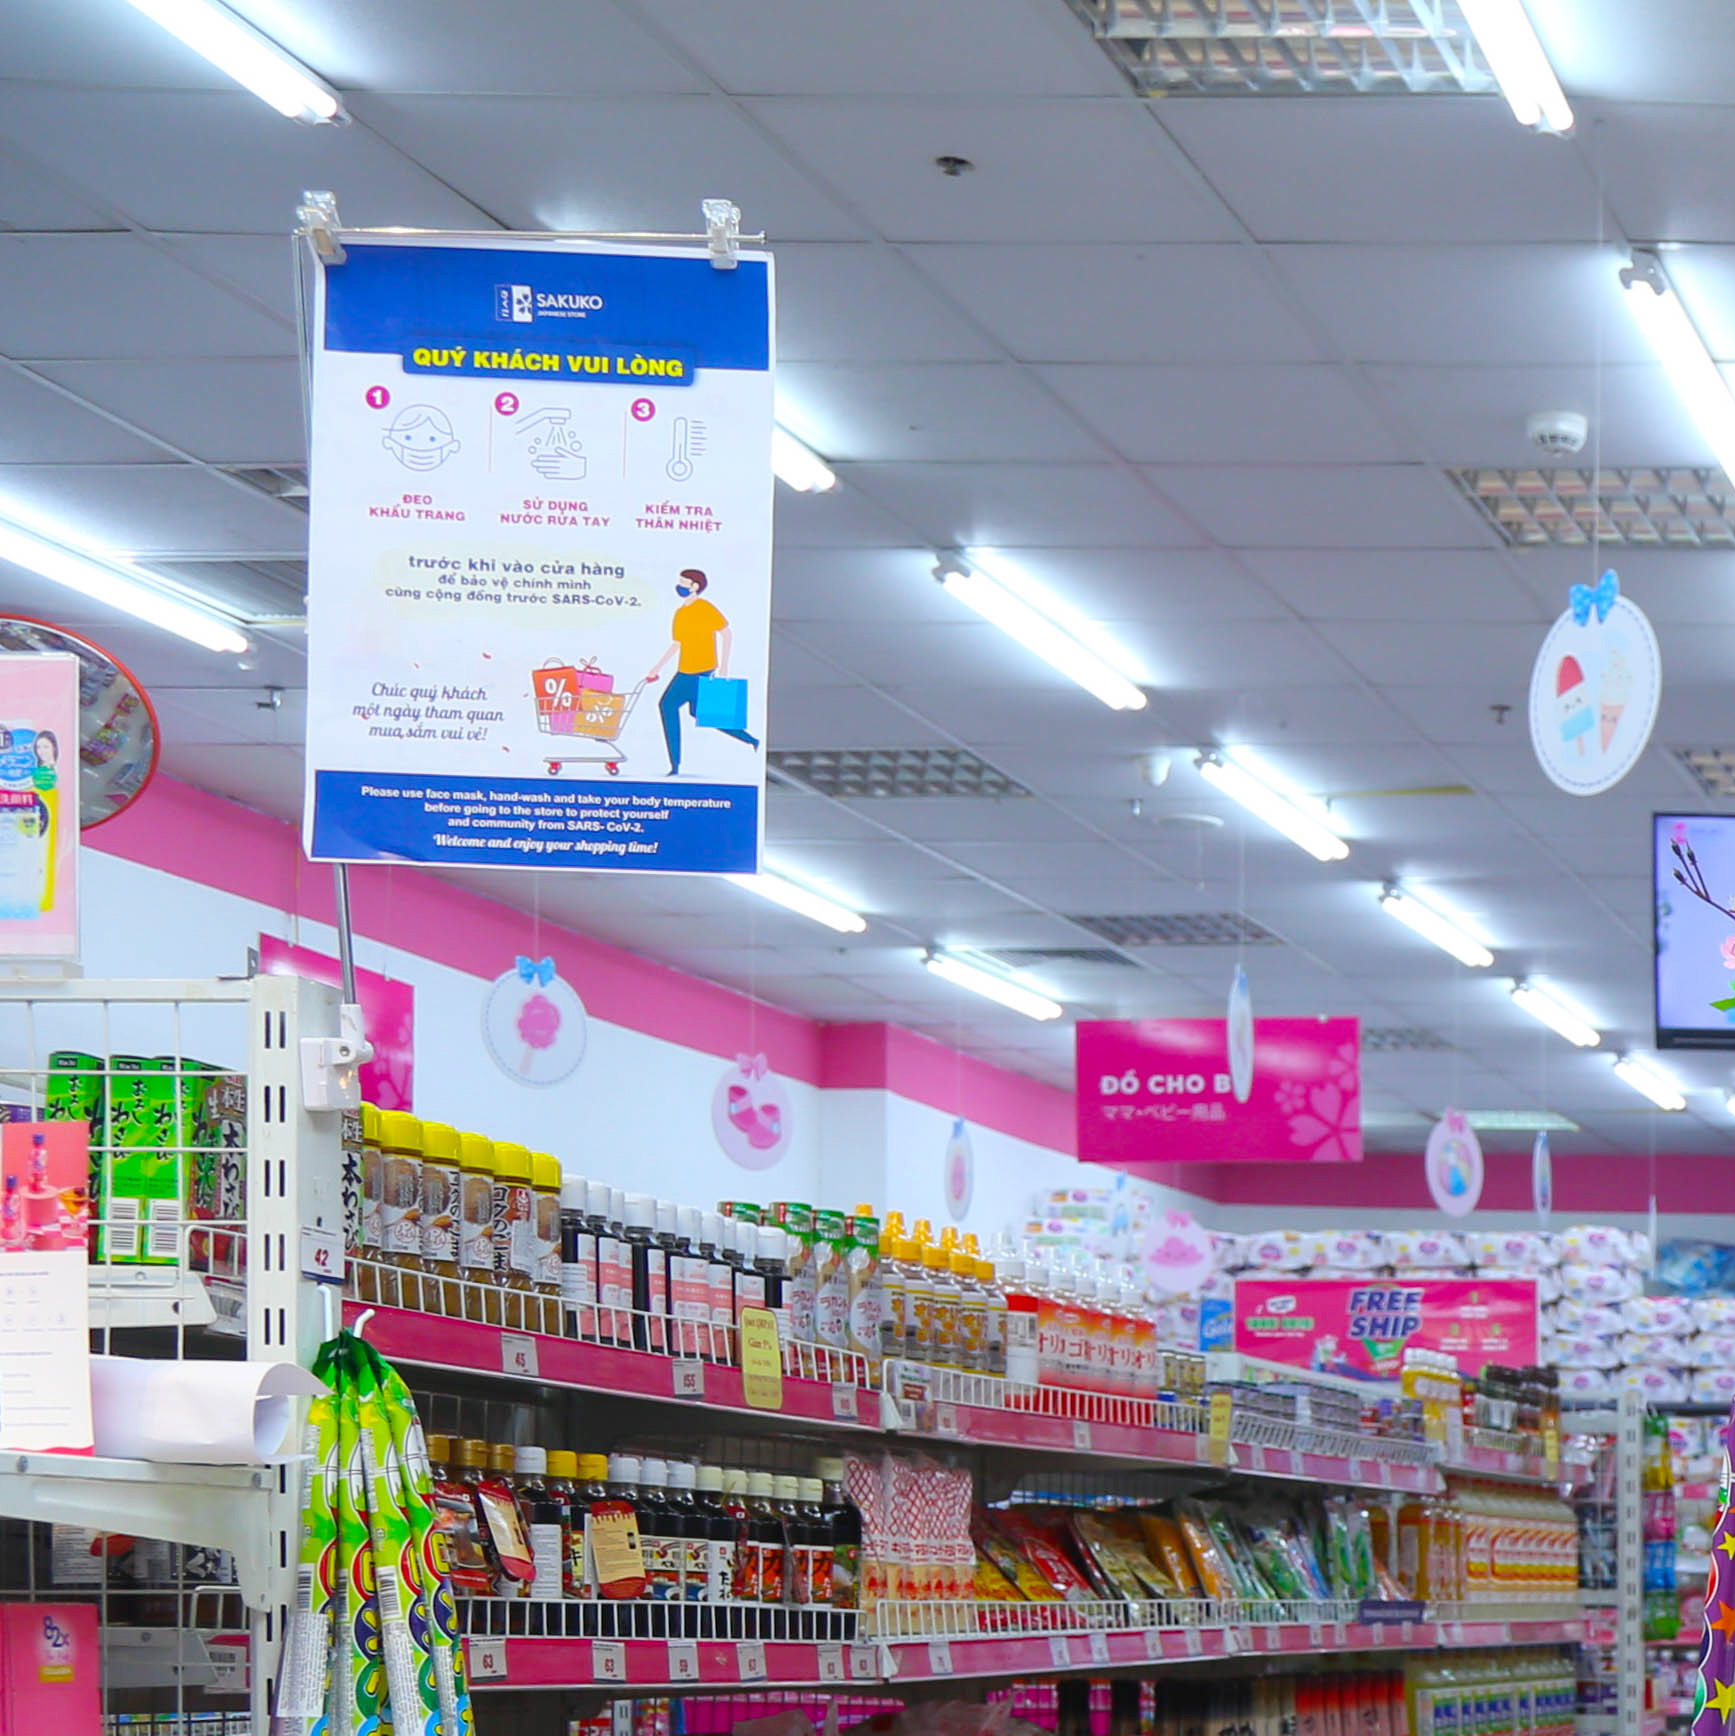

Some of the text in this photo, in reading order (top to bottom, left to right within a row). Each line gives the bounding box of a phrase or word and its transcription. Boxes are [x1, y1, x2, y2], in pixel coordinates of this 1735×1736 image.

[537, 293, 603, 311] SAKUKO
[413, 347, 684, 378] QUÝ KHÁCH VUI LÒNG
[403, 494, 433, 505] ĐEO
[416, 508, 465, 521] TRANG
[686, 506, 713, 517] TRA
[409, 555, 461, 571] trước
[468, 558, 495, 572] khi
[502, 558, 534, 573] vào
[582, 561, 625, 578] hàng
[361, 786, 400, 799] Please
[402, 790, 423, 800] use
[426, 789, 450, 801] face
[489, 791, 551, 804] hand-wash
[554, 793, 575, 804] and
[578, 794, 601, 805] take
[604, 796, 629, 809] your
[632, 795, 661, 809] body
[663, 797, 731, 810] temperature
[1148, 1074, 1206, 1096] CHO
[314, 1248, 329, 1266] 42
[1349, 1288, 1423, 1314] FREE
[1349, 1315, 1421, 1339] SHIP
